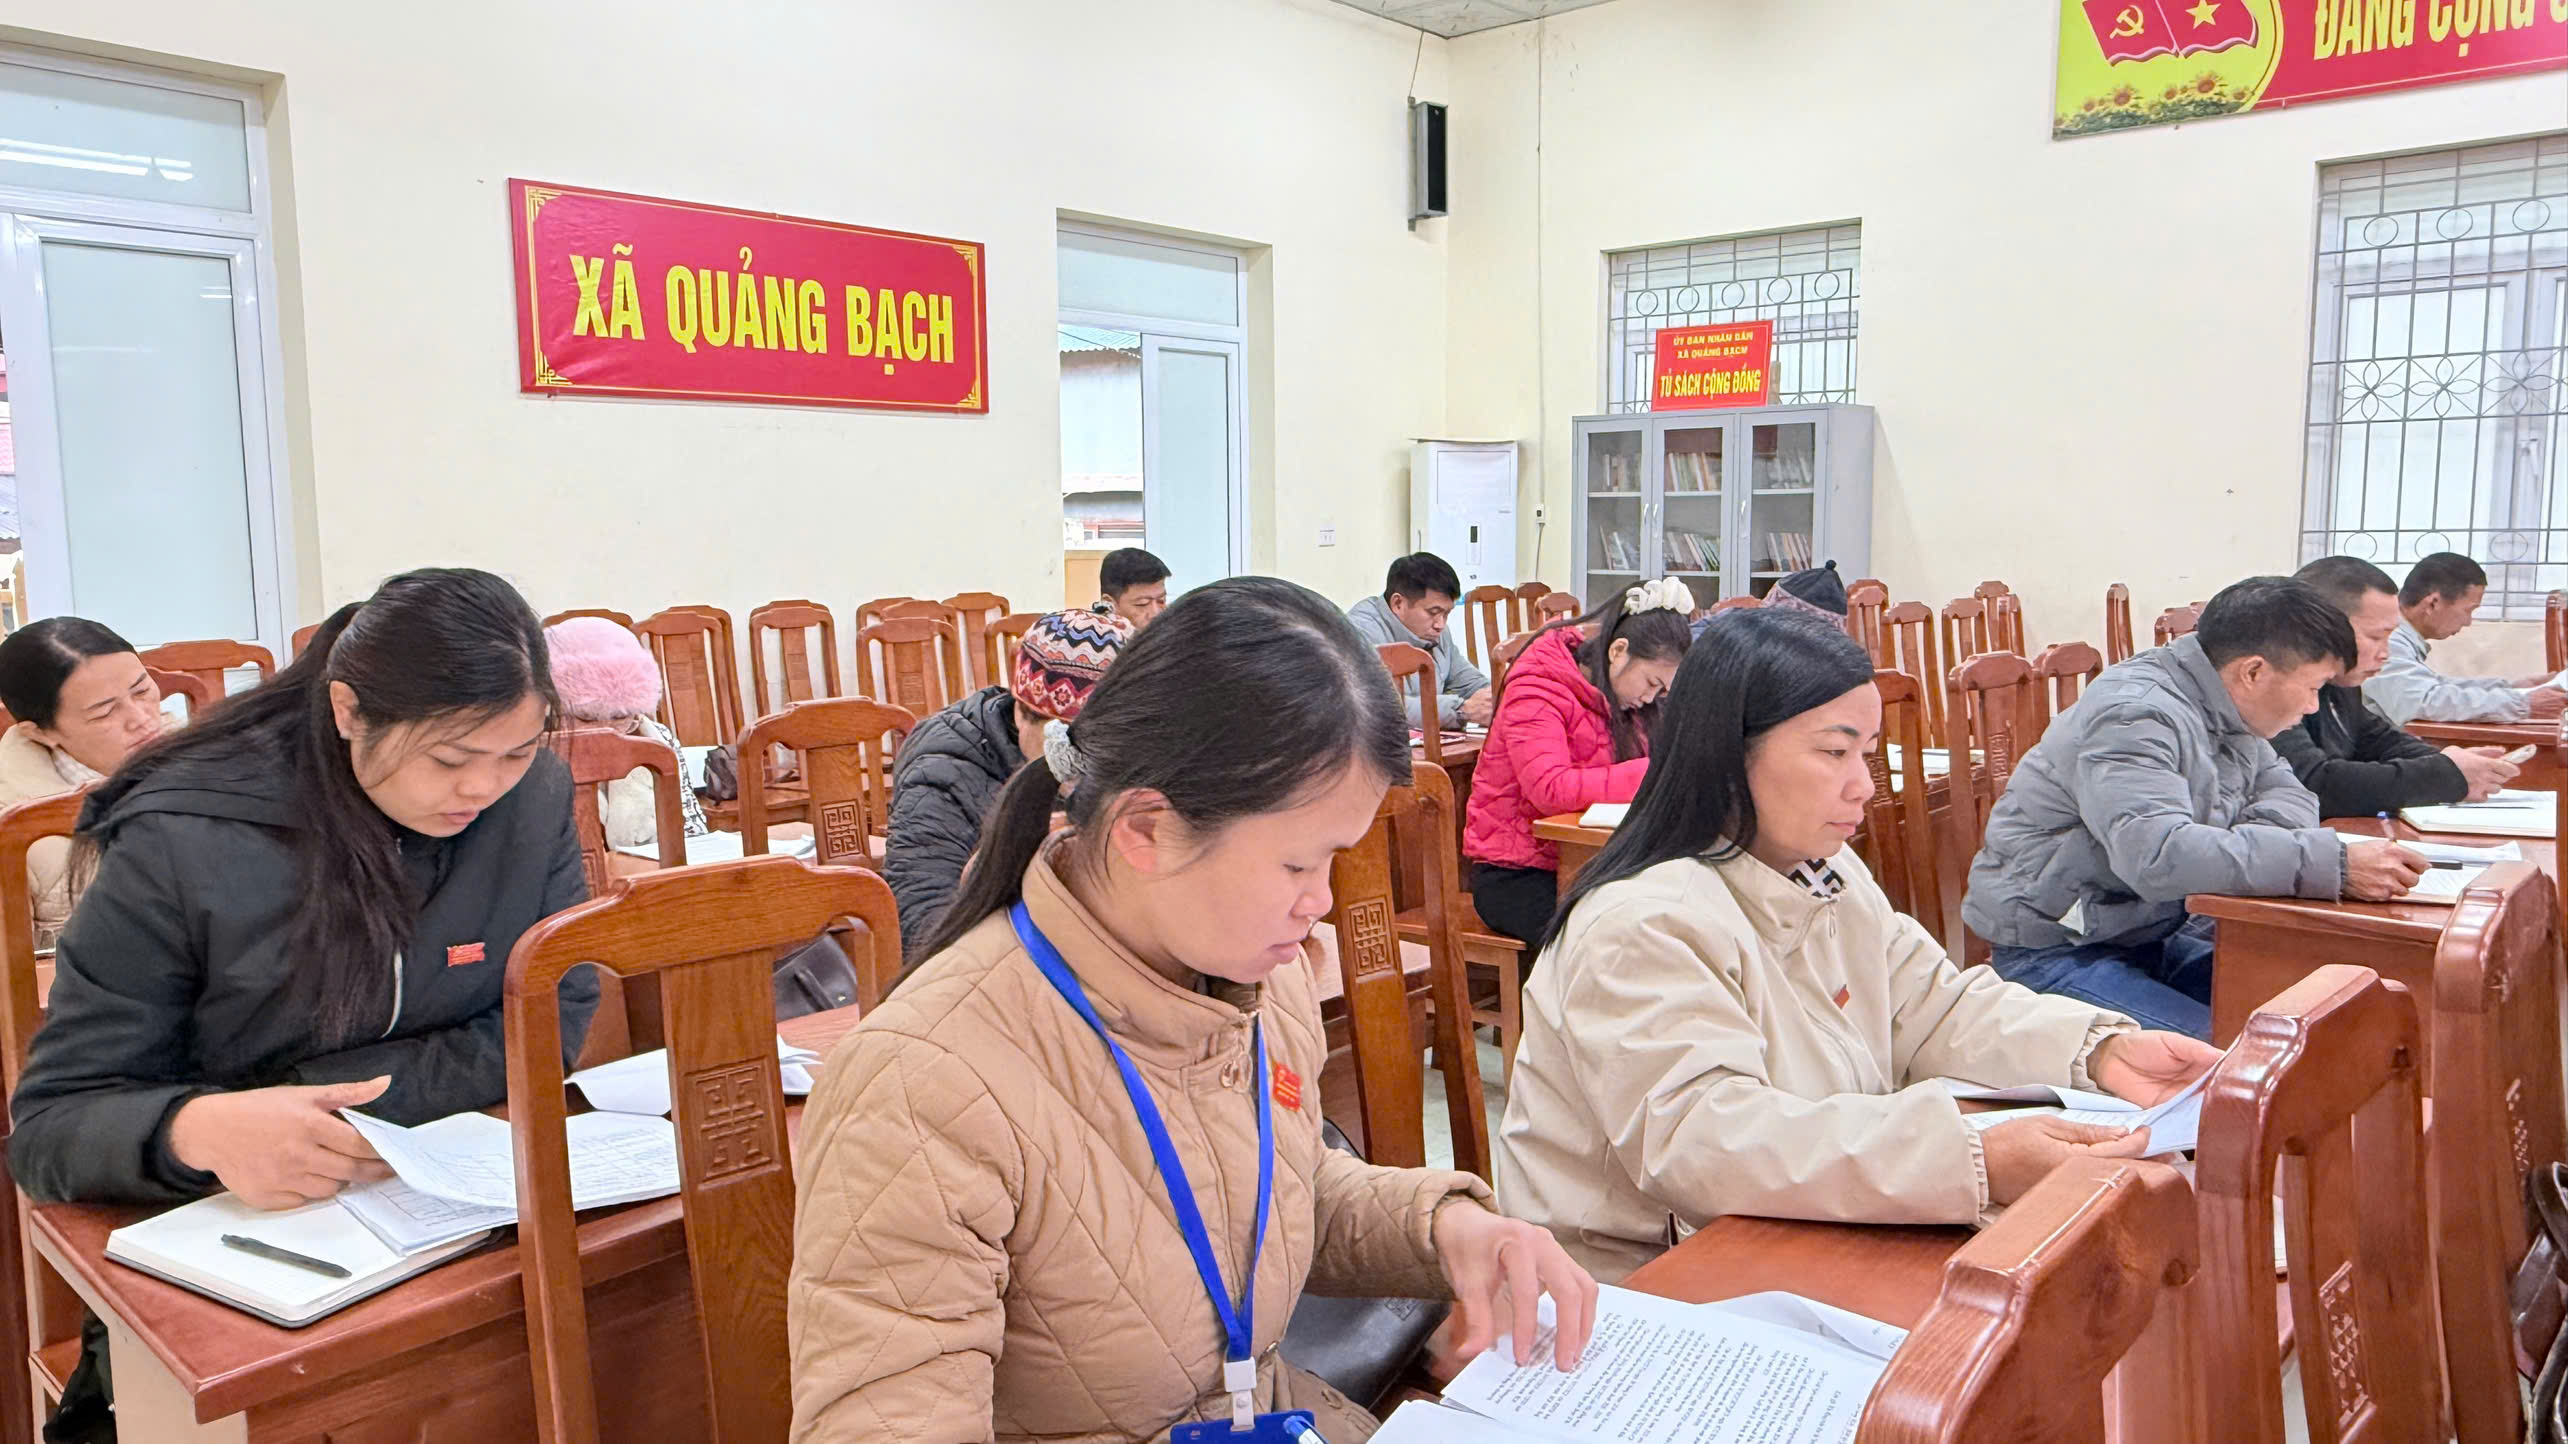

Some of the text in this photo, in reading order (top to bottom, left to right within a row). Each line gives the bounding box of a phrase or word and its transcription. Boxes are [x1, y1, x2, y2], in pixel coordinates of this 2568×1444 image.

[569, 243, 954, 376] XÃ QUẢNG BẠCH
[1687, 335, 1705, 345] BAN
[1691, 346, 1721, 359] QUẢNG
[1723, 346, 1749, 358] BẠCH
[1660, 368, 1673, 398] TỦ
[1674, 370, 1702, 397] SÁCH
[1703, 368, 1732, 400] CỘNG
